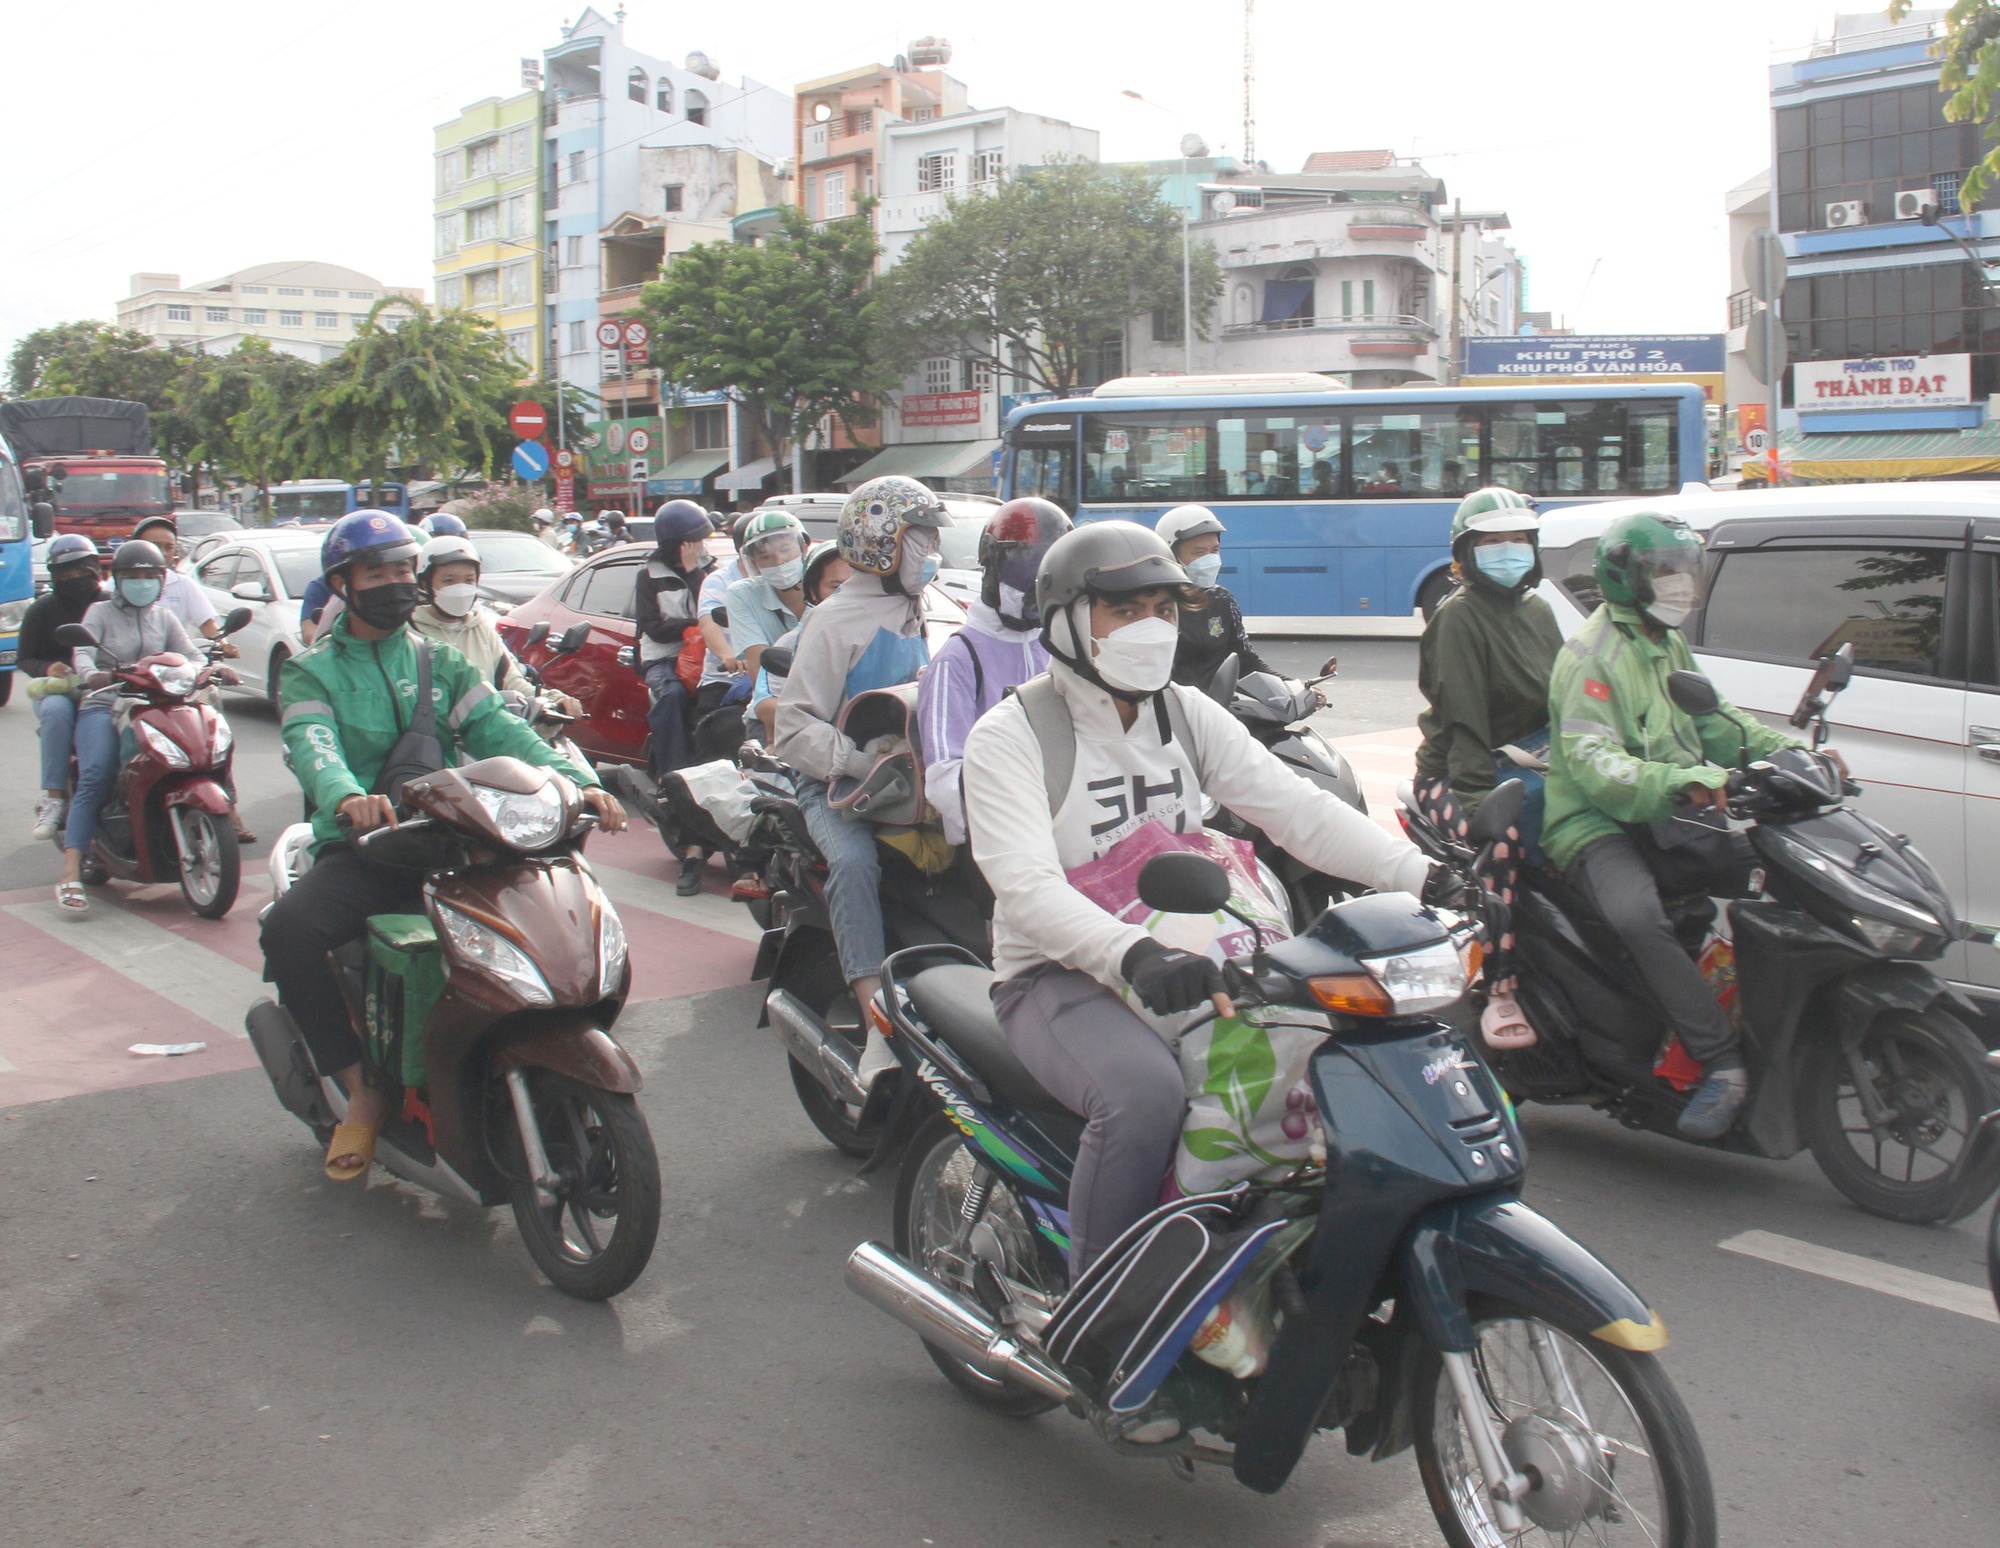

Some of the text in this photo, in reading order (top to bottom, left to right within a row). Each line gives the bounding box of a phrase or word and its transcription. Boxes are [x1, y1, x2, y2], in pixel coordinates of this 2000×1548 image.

[603, 327, 616, 340] 70
[1516, 347, 1665, 361] KHU PHỐ 2
[1843, 358, 1916, 373] PHÒNG TRỌ
[1497, 359, 1684, 373] KHU PHỐ VĂN HÓA
[1814, 375, 1947, 398] THÀNH ĐẠT
[396, 678, 443, 701] Grb
[1576, 734, 1639, 785] Grab
[916, 1057, 984, 1125] Wave
[942, 1107, 974, 1137] 110
